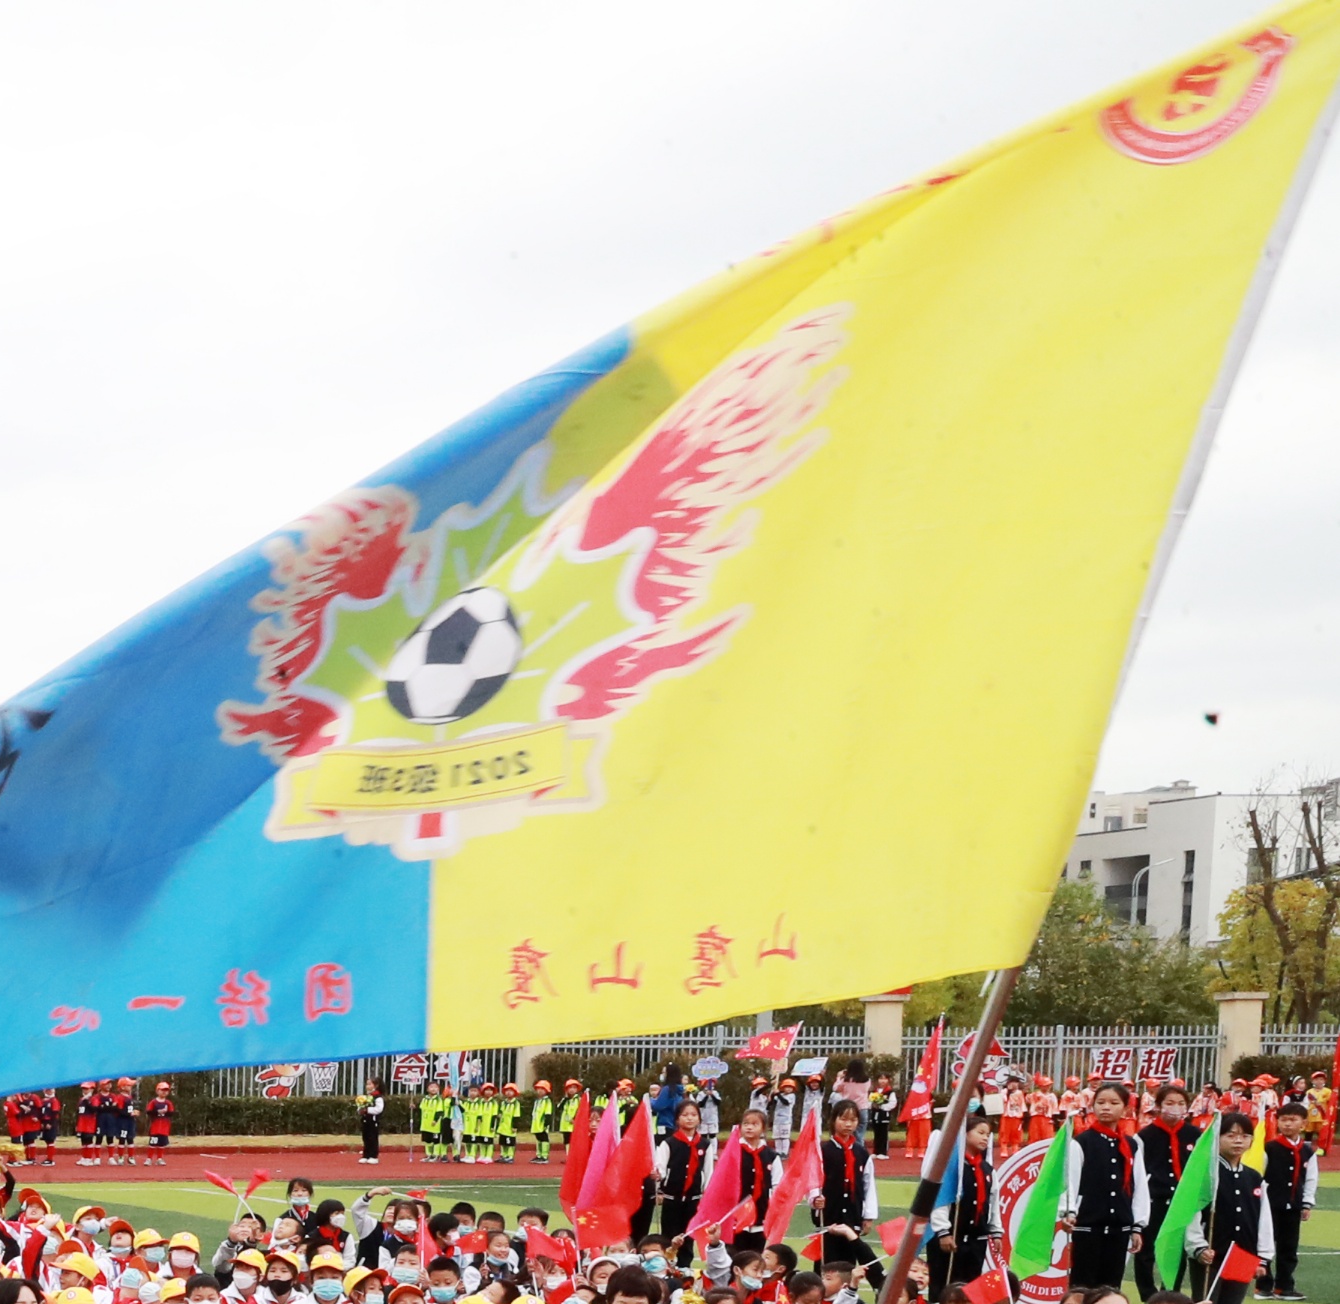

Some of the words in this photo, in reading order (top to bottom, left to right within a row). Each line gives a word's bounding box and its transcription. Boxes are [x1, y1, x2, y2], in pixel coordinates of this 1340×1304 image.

[1093, 1048, 1178, 1081] 超越
[1021, 1281, 1037, 1293] SHI
[1038, 1285, 1049, 1295] DI
[1051, 1286, 1064, 1295] ER
